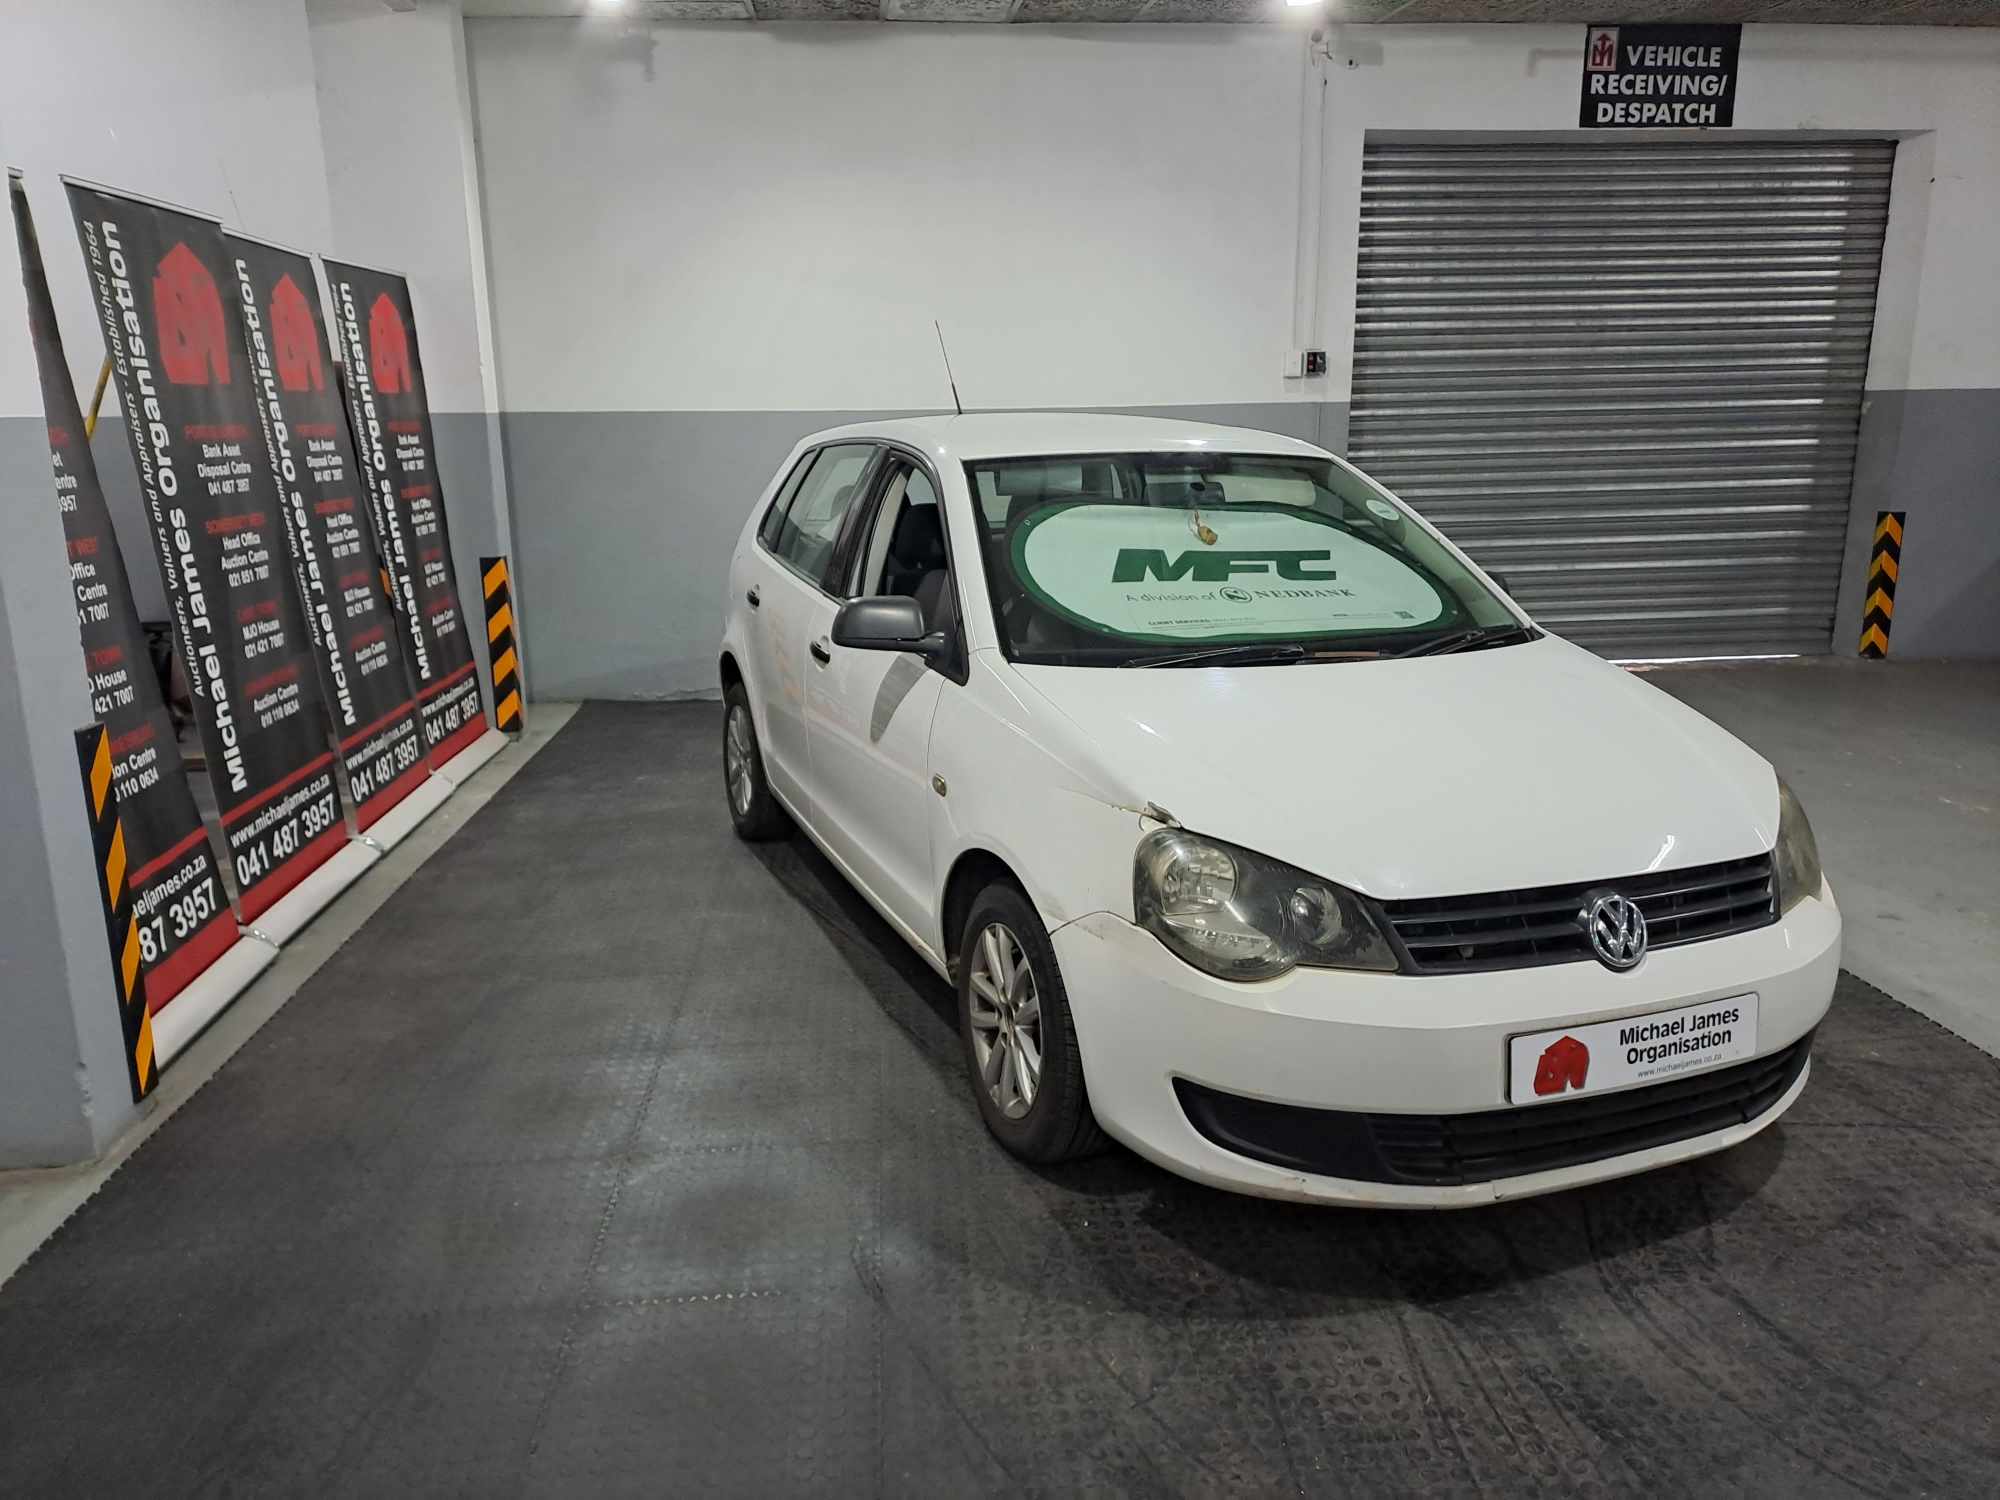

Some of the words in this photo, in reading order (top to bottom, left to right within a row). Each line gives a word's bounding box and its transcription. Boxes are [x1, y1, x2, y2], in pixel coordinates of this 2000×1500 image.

[1626, 45, 1722, 68] VEHICLE
[1590, 73, 1728, 97] RECEIVING/
[1596, 102, 1716, 124] DESPATCH
[83, 220, 102, 268] 1964
[100, 272, 129, 374] Established
[102, 220, 178, 497] Organisation
[235, 258, 296, 483] Organisation
[340, 282, 387, 472] Organisation
[126, 389, 155, 490] Appraisers
[55, 474, 78, 491] entre
[146, 489, 162, 523] and
[290, 491, 325, 597] James
[381, 479, 408, 568] James
[158, 526, 179, 590] Valuers
[170, 507, 212, 635] James
[1112, 548, 1337, 583] MFC
[87, 601, 110, 623] 7007
[1125, 593, 1139, 602] A
[1140, 591, 1197, 602] division
[1201, 590, 1218, 602] of
[1253, 587, 1357, 600] NEDBANK
[399, 574, 431, 681] Michael
[93, 669, 128, 691] House
[316, 603, 357, 728] Michael
[94, 693, 114, 714] 421
[113, 685, 134, 707] 7007
[199, 643, 248, 793] Michael
[425, 714, 445, 744] 041
[445, 703, 460, 731] 487
[460, 690, 478, 720] 3957
[120, 777, 139, 798] 110
[138, 766, 160, 789] 0634
[129, 745, 157, 769] Centre
[351, 767, 375, 802] 041
[375, 751, 395, 784] 487
[394, 734, 418, 771] 3957
[236, 840, 269, 886] 041
[273, 818, 299, 858] 487
[301, 792, 335, 838] 3957
[139, 915, 167, 962] 87
[169, 877, 216, 938] 3957
[1619, 1016, 1685, 1046] Michael
[1689, 1007, 1740, 1032] James
[1626, 1028, 1732, 1065] Organisation
